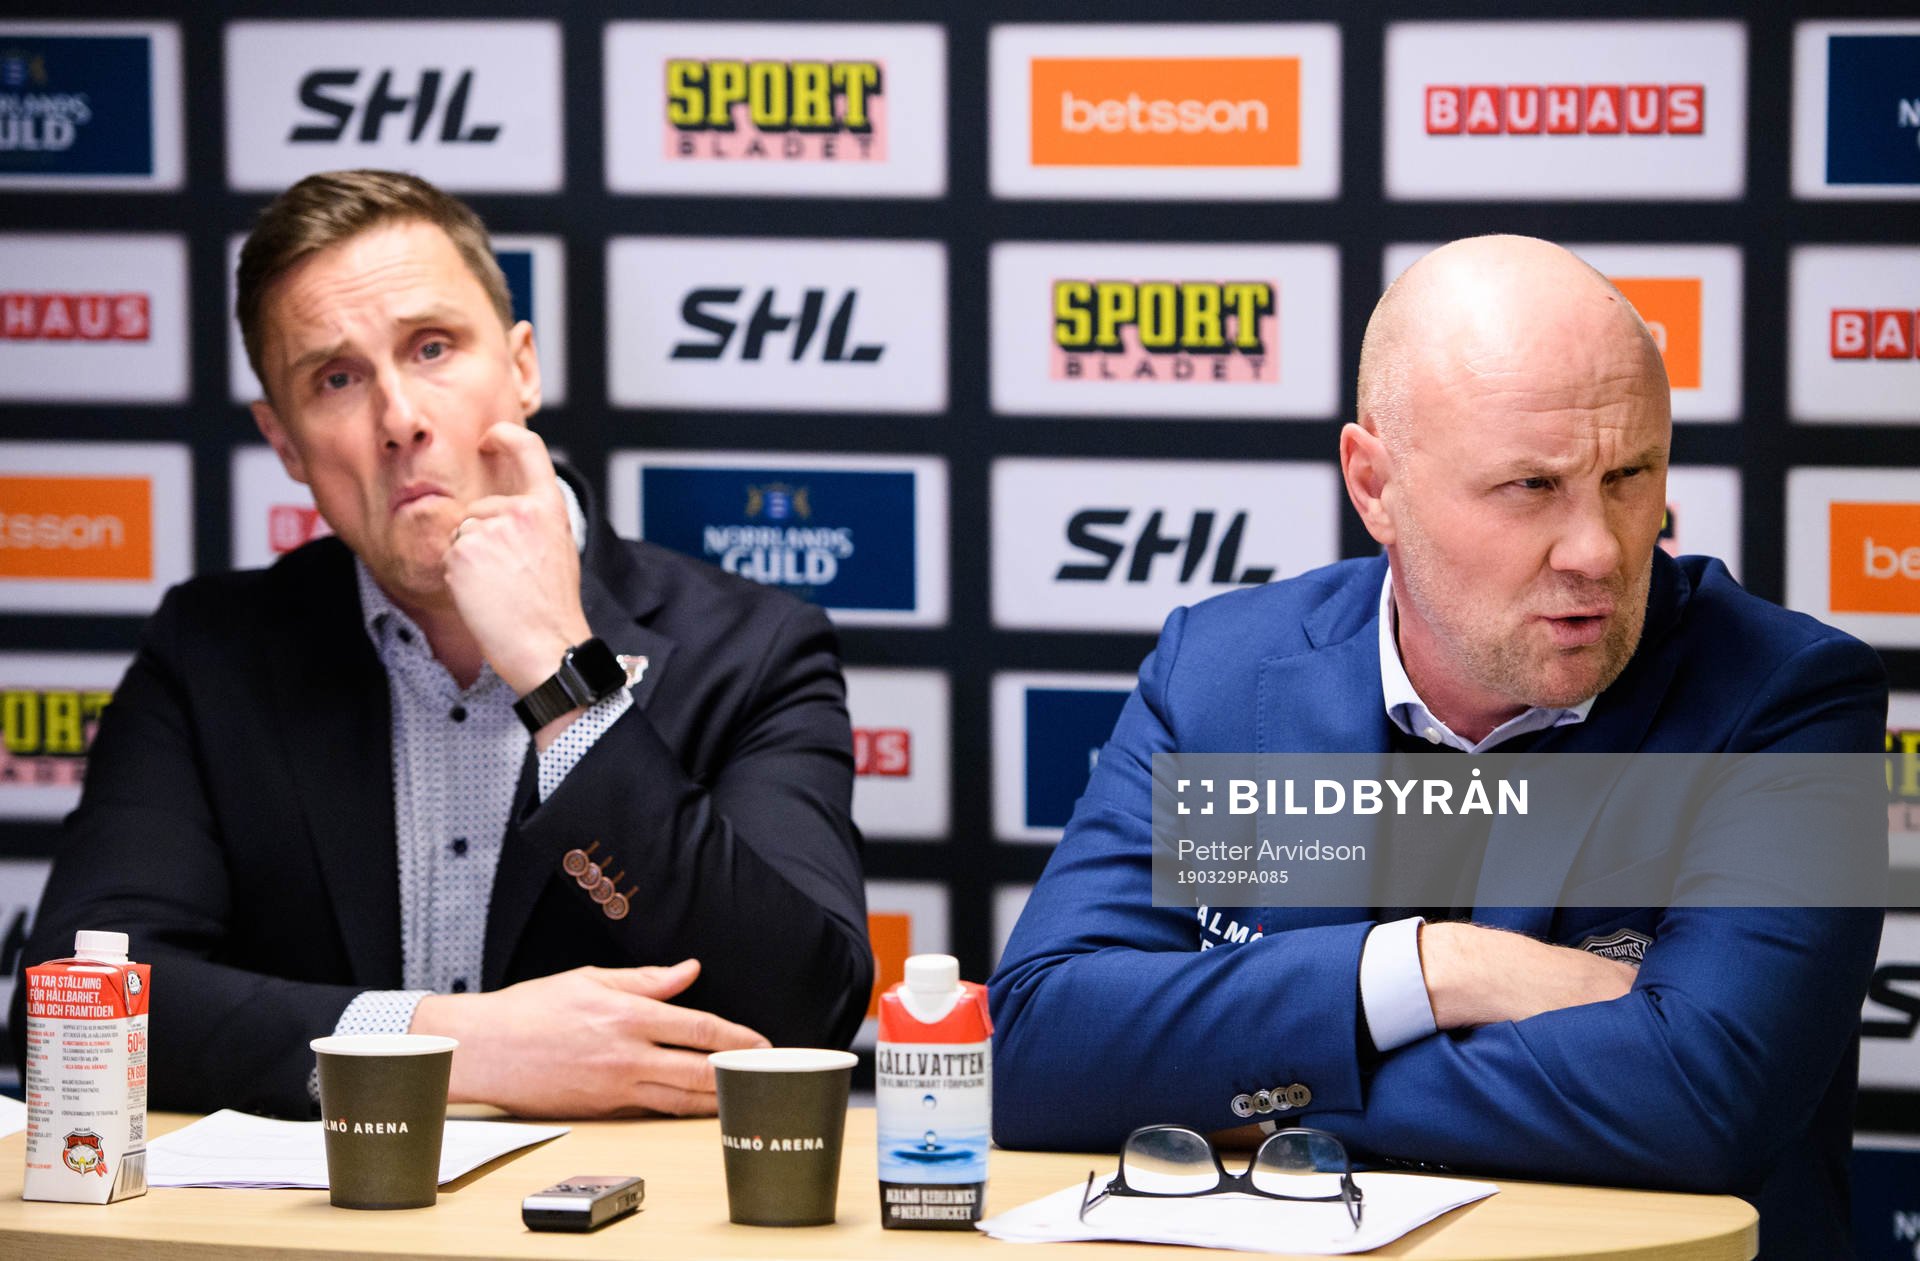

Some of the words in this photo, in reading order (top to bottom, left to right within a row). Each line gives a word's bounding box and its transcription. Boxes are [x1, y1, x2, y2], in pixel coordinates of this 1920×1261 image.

[288, 69, 503, 143] SHL
[666, 59, 883, 134] SPORT
[1061, 92, 1268, 133] betsson
[1428, 89, 1702, 130] BAUHAUS
[679, 134, 873, 158] BLADET
[3, 294, 147, 336] HAUS
[669, 286, 887, 362] SHL
[1053, 280, 1276, 354] SPORT
[1065, 355, 1266, 380] BLADET
[704, 525, 854, 559] NORRLANDS
[1056, 509, 1275, 583] SHL
[721, 546, 838, 585] GULD
[30, 986, 45, 1001] FÖR
[31, 975, 39, 987] VI
[41, 975, 56, 988] TAR
[58, 975, 101, 989] STÄLLNING
[47, 1003, 63, 1016] OCH
[65, 1004, 114, 1017] FRAMTIDEN
[127, 1032, 146, 1053] 50%
[353, 1122, 409, 1134] ARENA
[770, 1137, 824, 1151] ARENA
